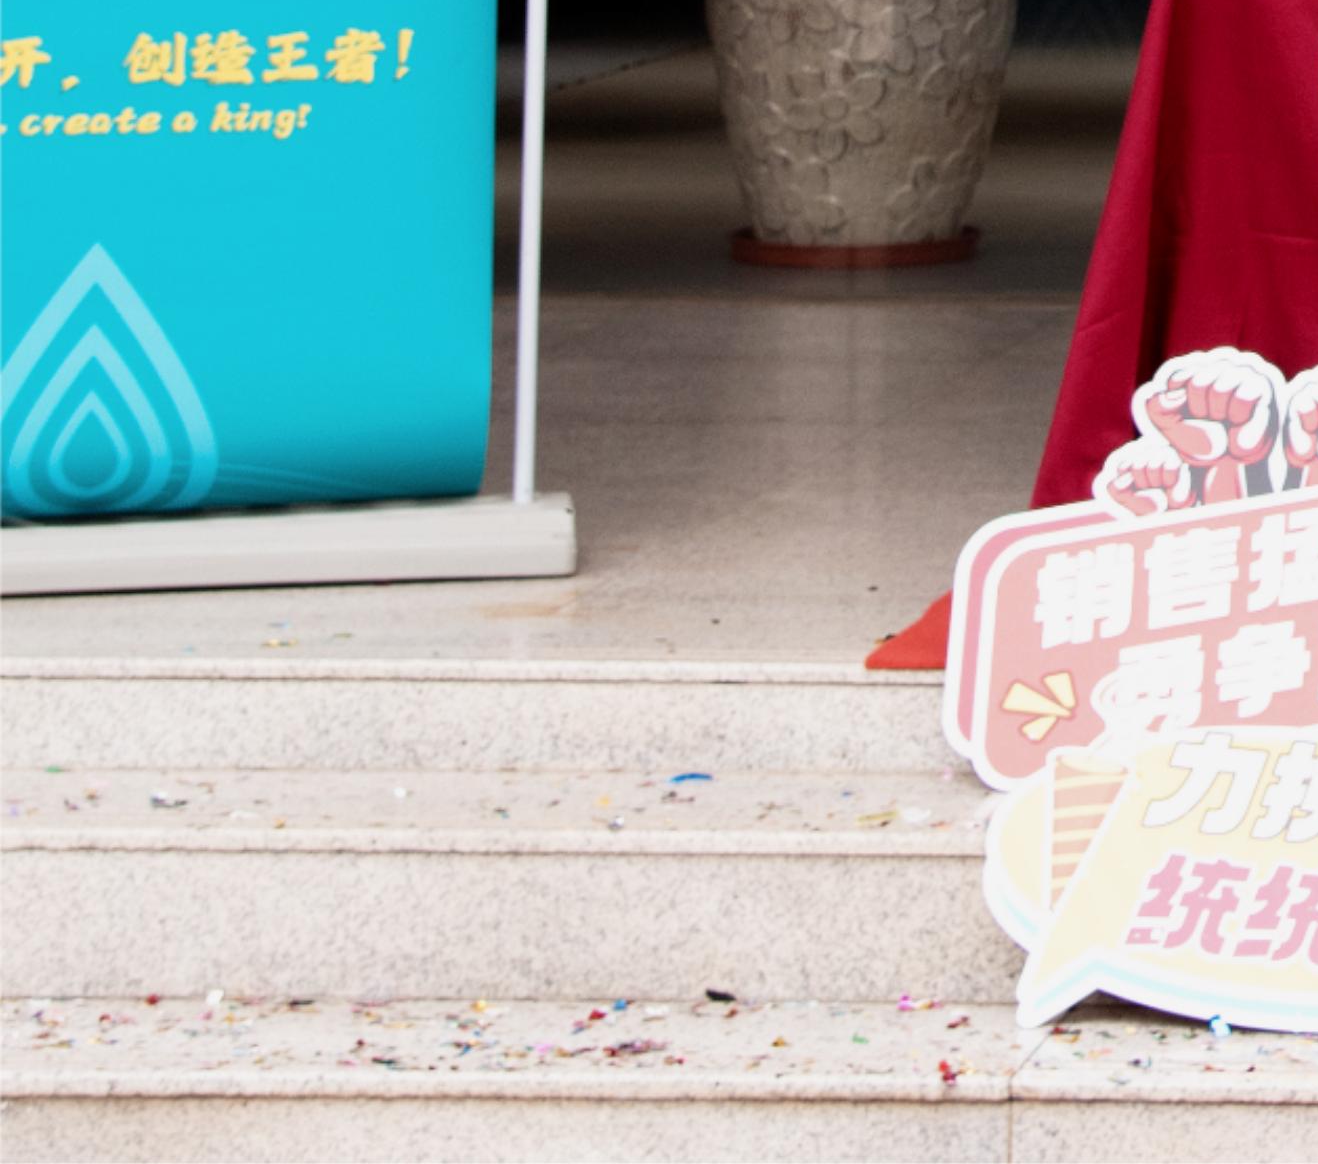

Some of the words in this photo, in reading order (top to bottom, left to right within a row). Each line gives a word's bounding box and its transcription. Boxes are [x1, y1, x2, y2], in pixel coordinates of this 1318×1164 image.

[19, 108, 162, 136] create
[172, 110, 197, 132] a
[209, 102, 312, 140] king!
